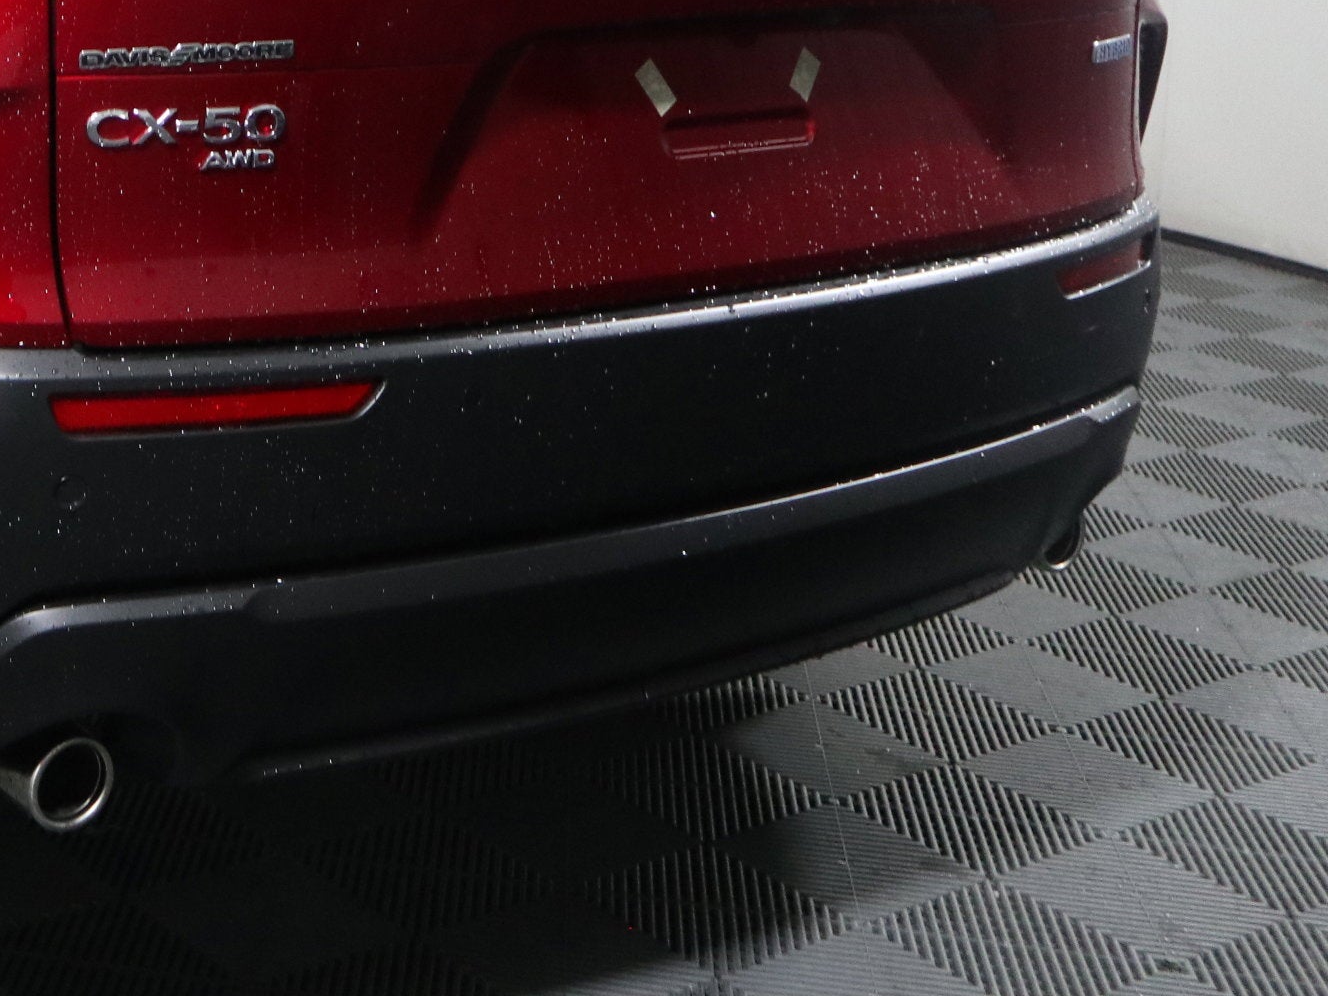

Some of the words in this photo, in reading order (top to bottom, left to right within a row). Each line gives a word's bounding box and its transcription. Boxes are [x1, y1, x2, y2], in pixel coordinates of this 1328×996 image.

[78, 46, 172, 70] DAVIS
[192, 39, 295, 64] MOORE
[86, 103, 286, 148] CX-50
[199, 148, 276, 171] AWD
